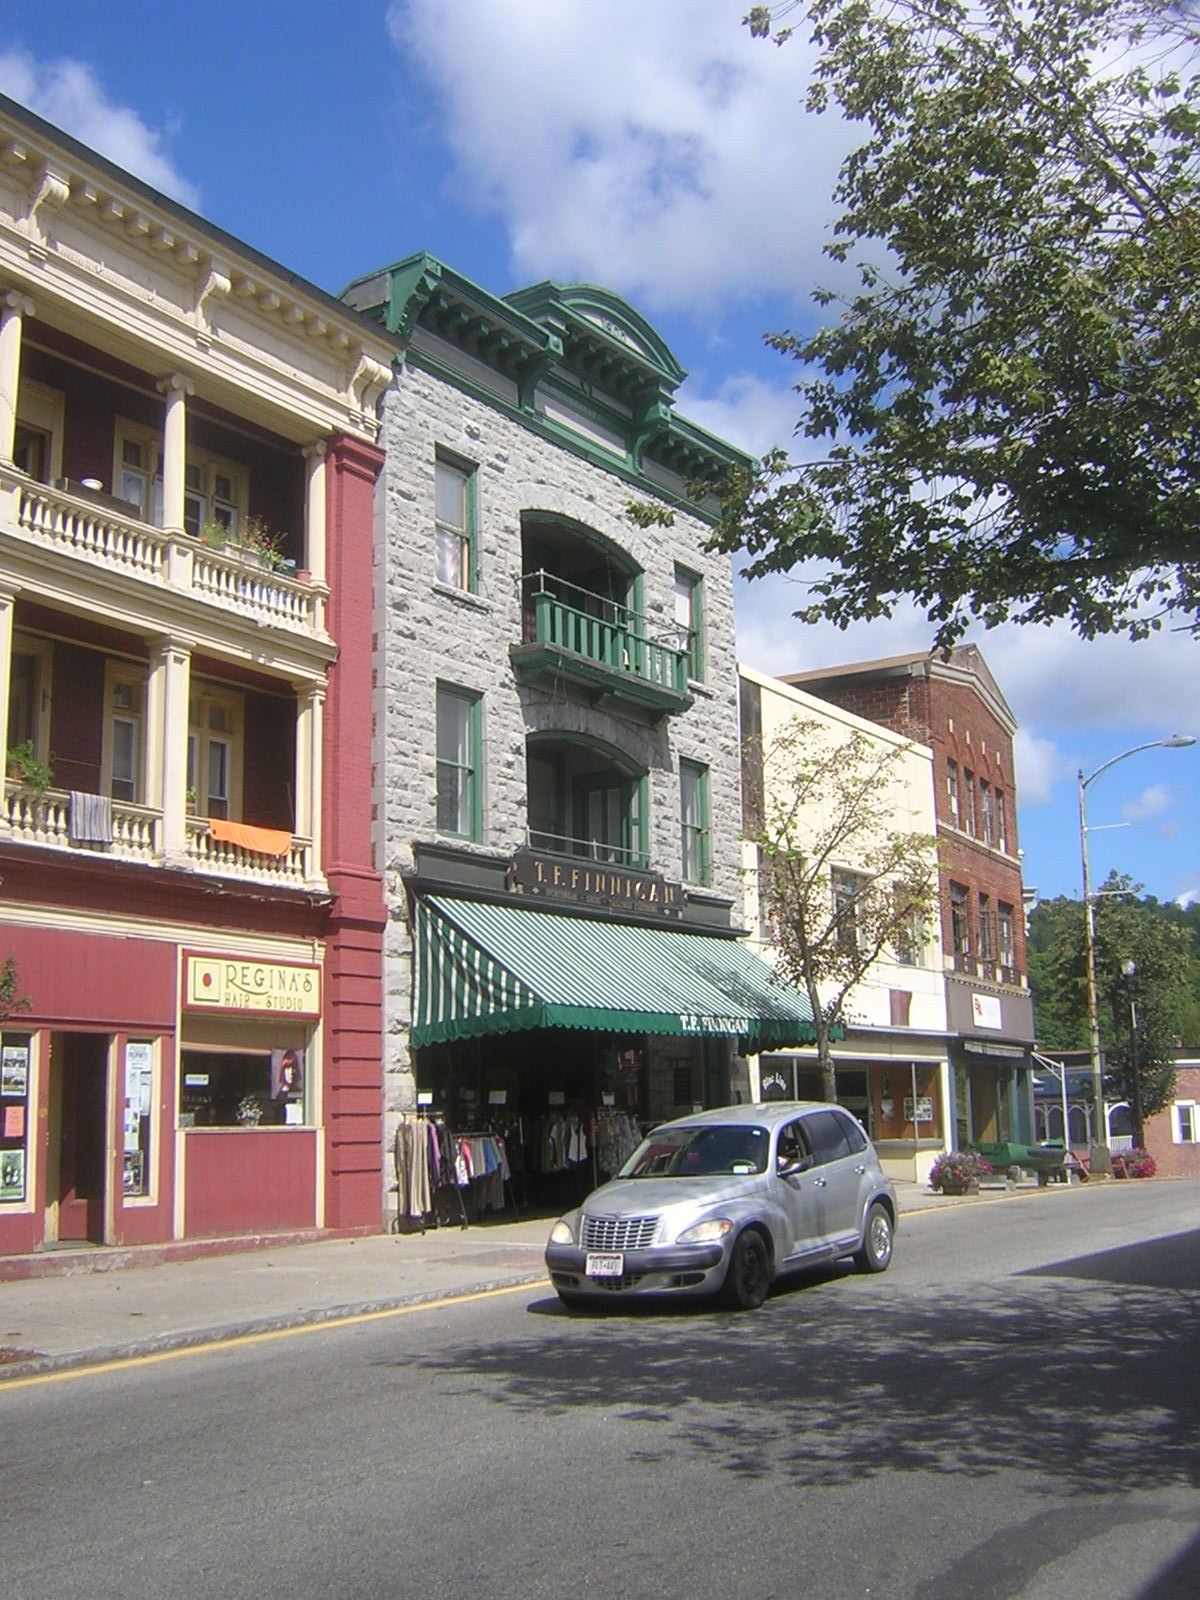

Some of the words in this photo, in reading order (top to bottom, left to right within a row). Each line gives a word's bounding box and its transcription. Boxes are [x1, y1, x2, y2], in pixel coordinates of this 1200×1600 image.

[571, 868, 674, 904] FINNIGAN
[225, 964, 313, 995] REGINA'S
[224, 992, 250, 1009] HAIR
[266, 994, 303, 1011] STUDIO
